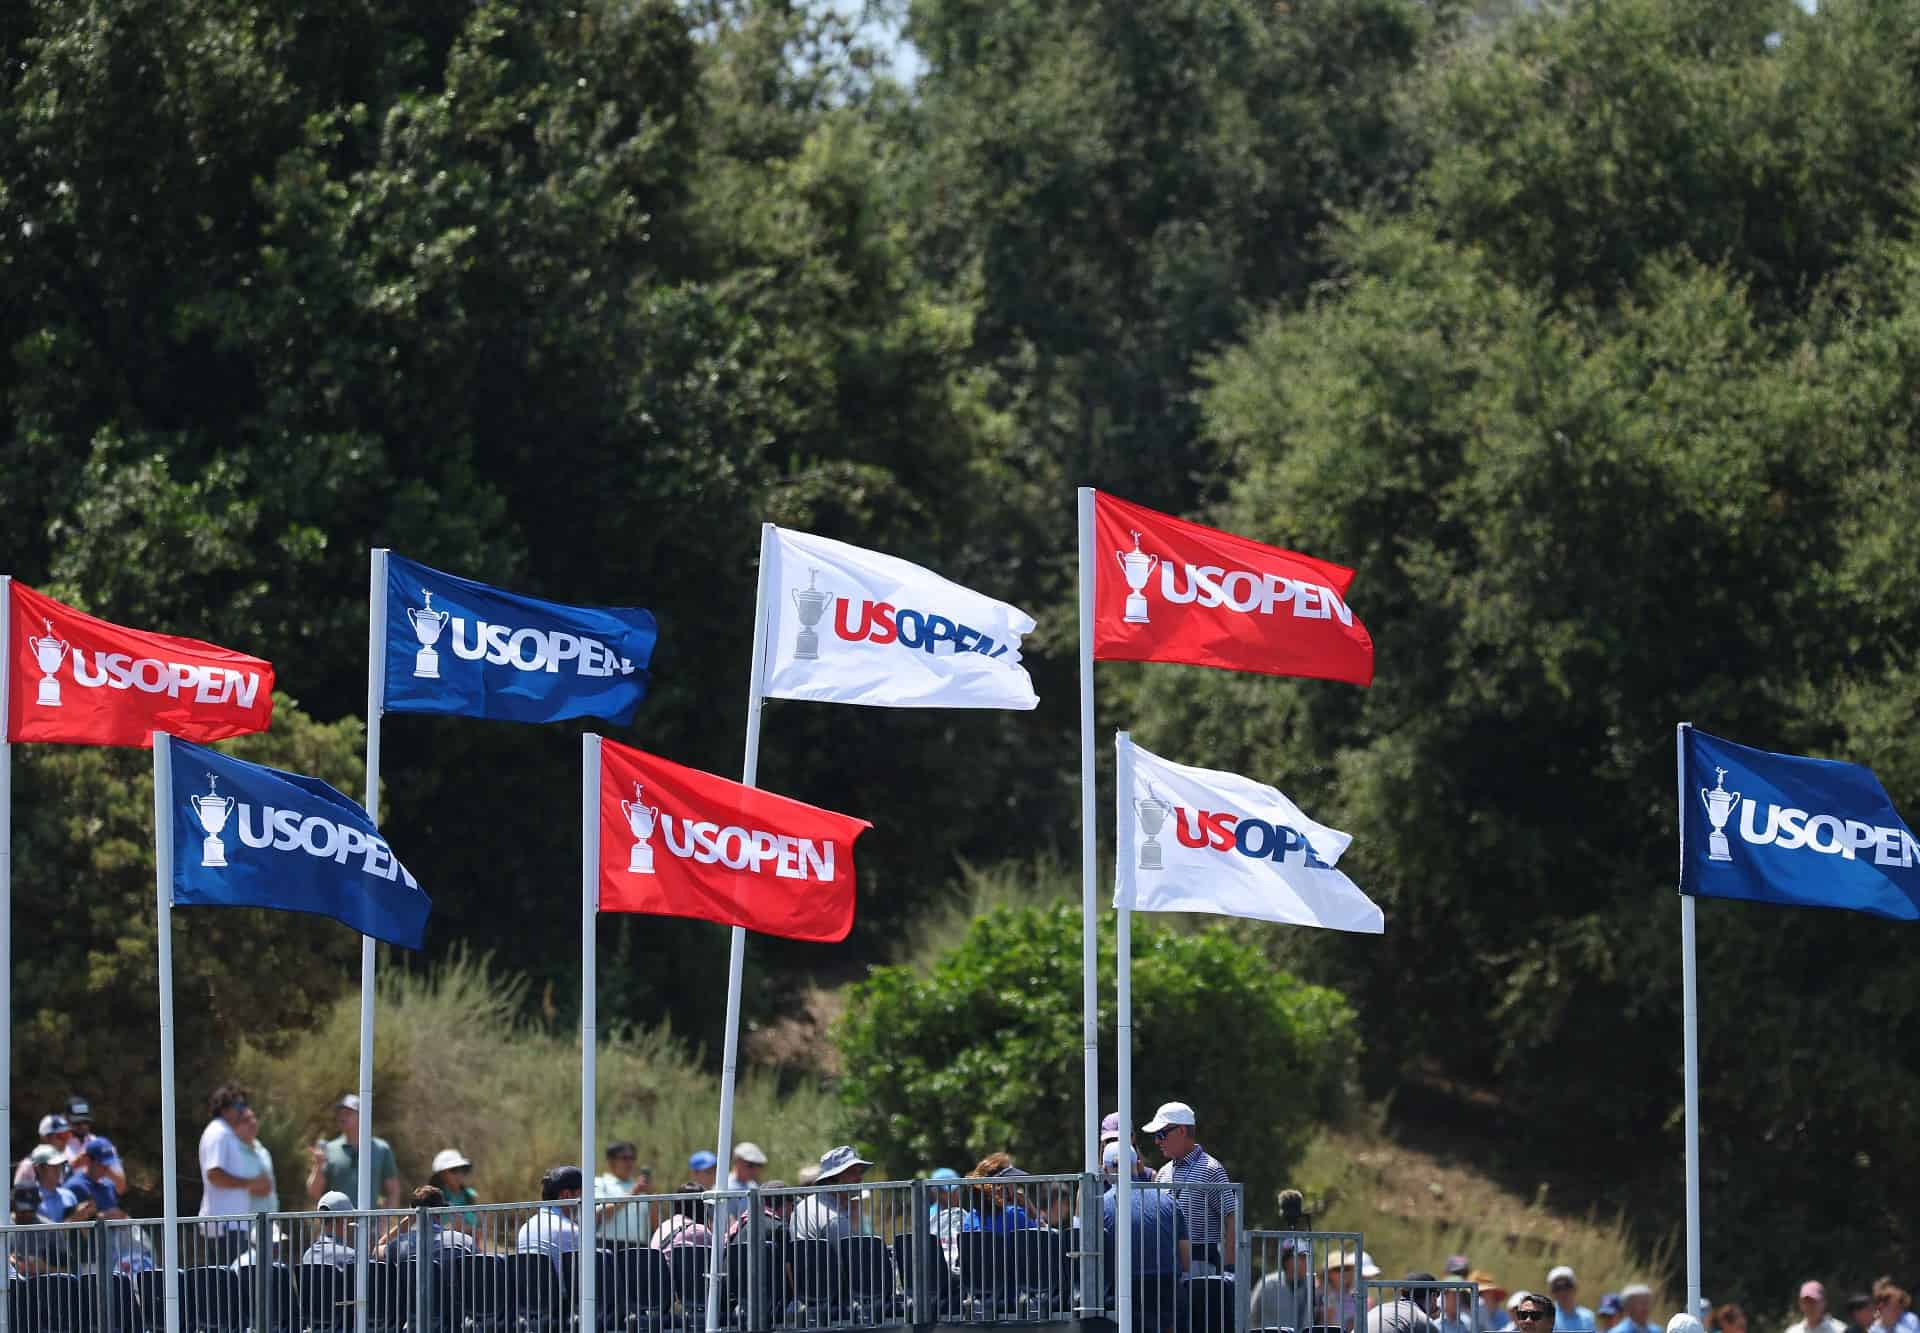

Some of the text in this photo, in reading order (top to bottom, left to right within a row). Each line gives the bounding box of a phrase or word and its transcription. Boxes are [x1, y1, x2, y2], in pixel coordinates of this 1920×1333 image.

[1161, 560, 1353, 628] USOPEN
[72, 647, 260, 709] USOPEN
[661, 813, 835, 882] USOPEN
